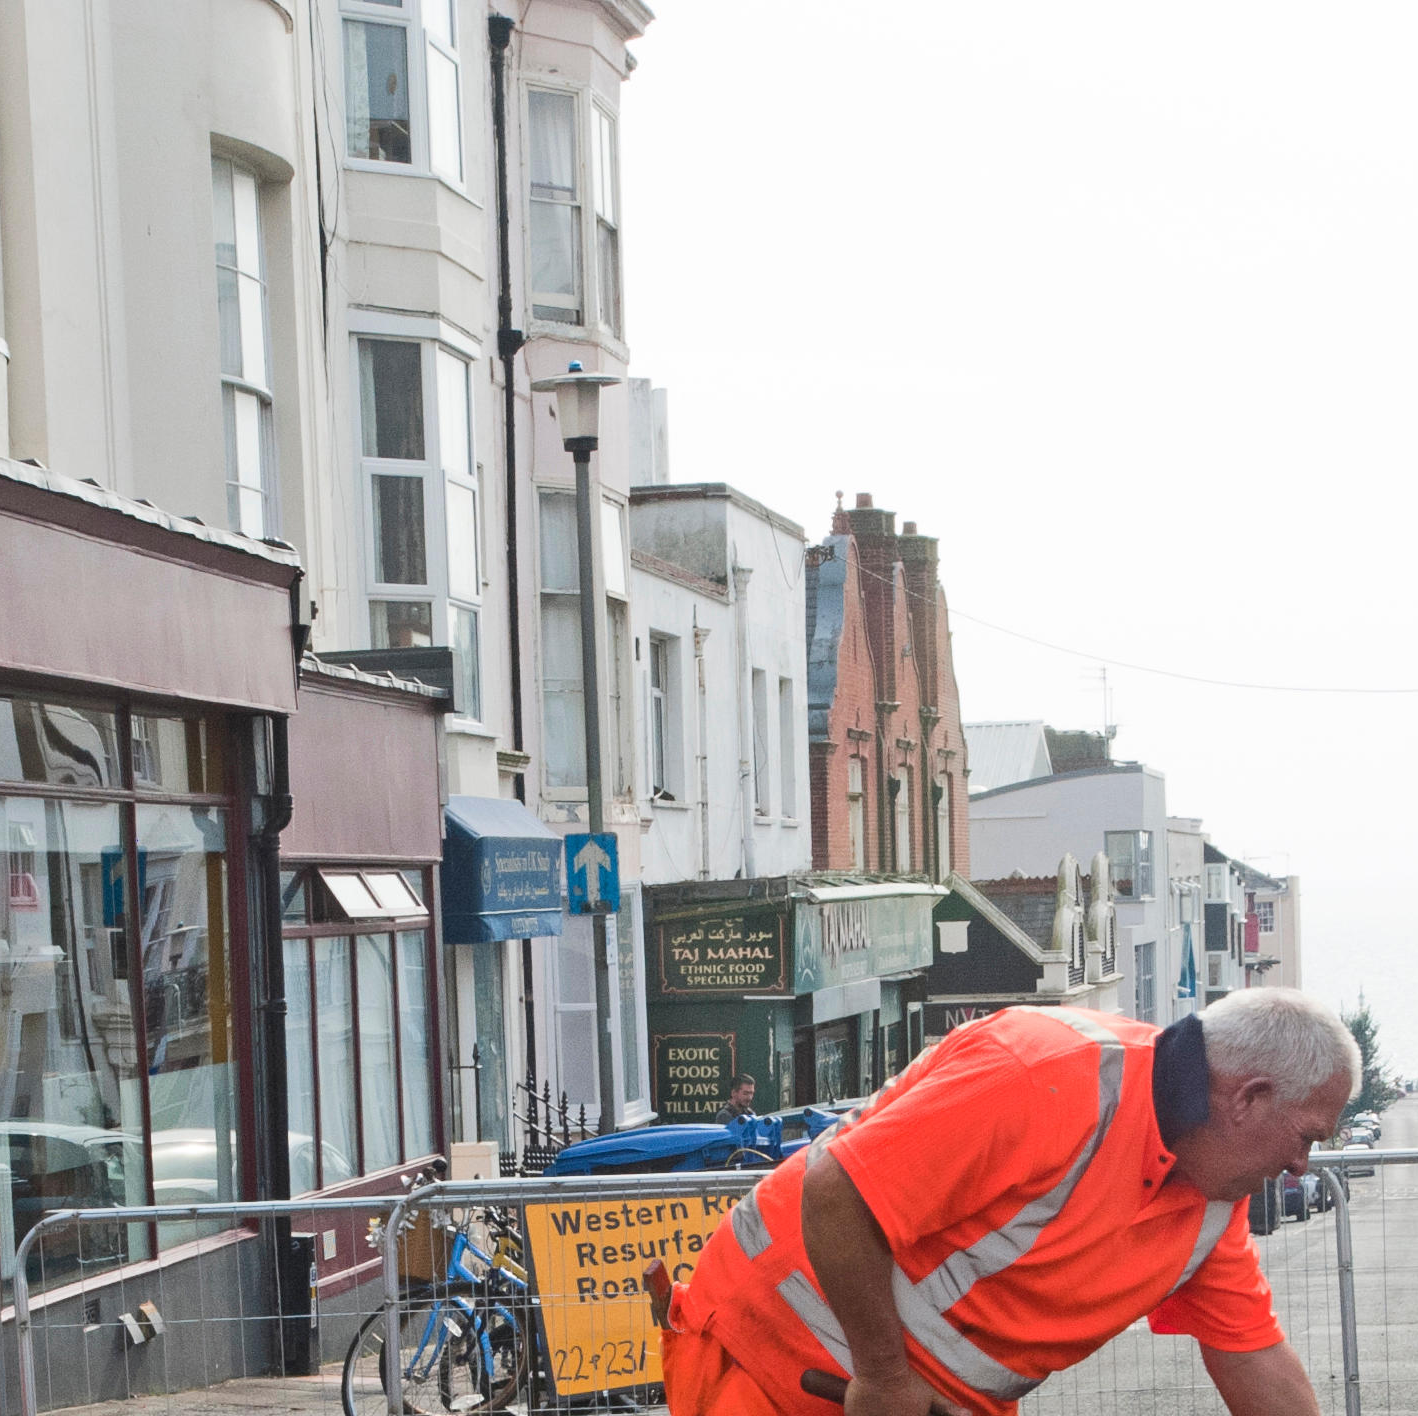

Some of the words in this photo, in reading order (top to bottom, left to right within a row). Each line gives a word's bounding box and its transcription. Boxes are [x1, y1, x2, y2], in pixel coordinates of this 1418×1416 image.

[671, 947, 701, 964] TAJ
[706, 945, 775, 960] MAHAL
[680, 964, 726, 975] ETHNIC
[729, 963, 766, 974] FOOD
[686, 974, 761, 986] SPECIALISTS
[668, 1047, 720, 1060] EXOTIC
[668, 1066, 721, 1078] FOODS
[670, 1083, 680, 1096] 7
[682, 1083, 720, 1096] DAYS
[663, 1101, 692, 1114] TILL
[550, 1201, 689, 1236] Western
[554, 1345, 590, 1382] 22
